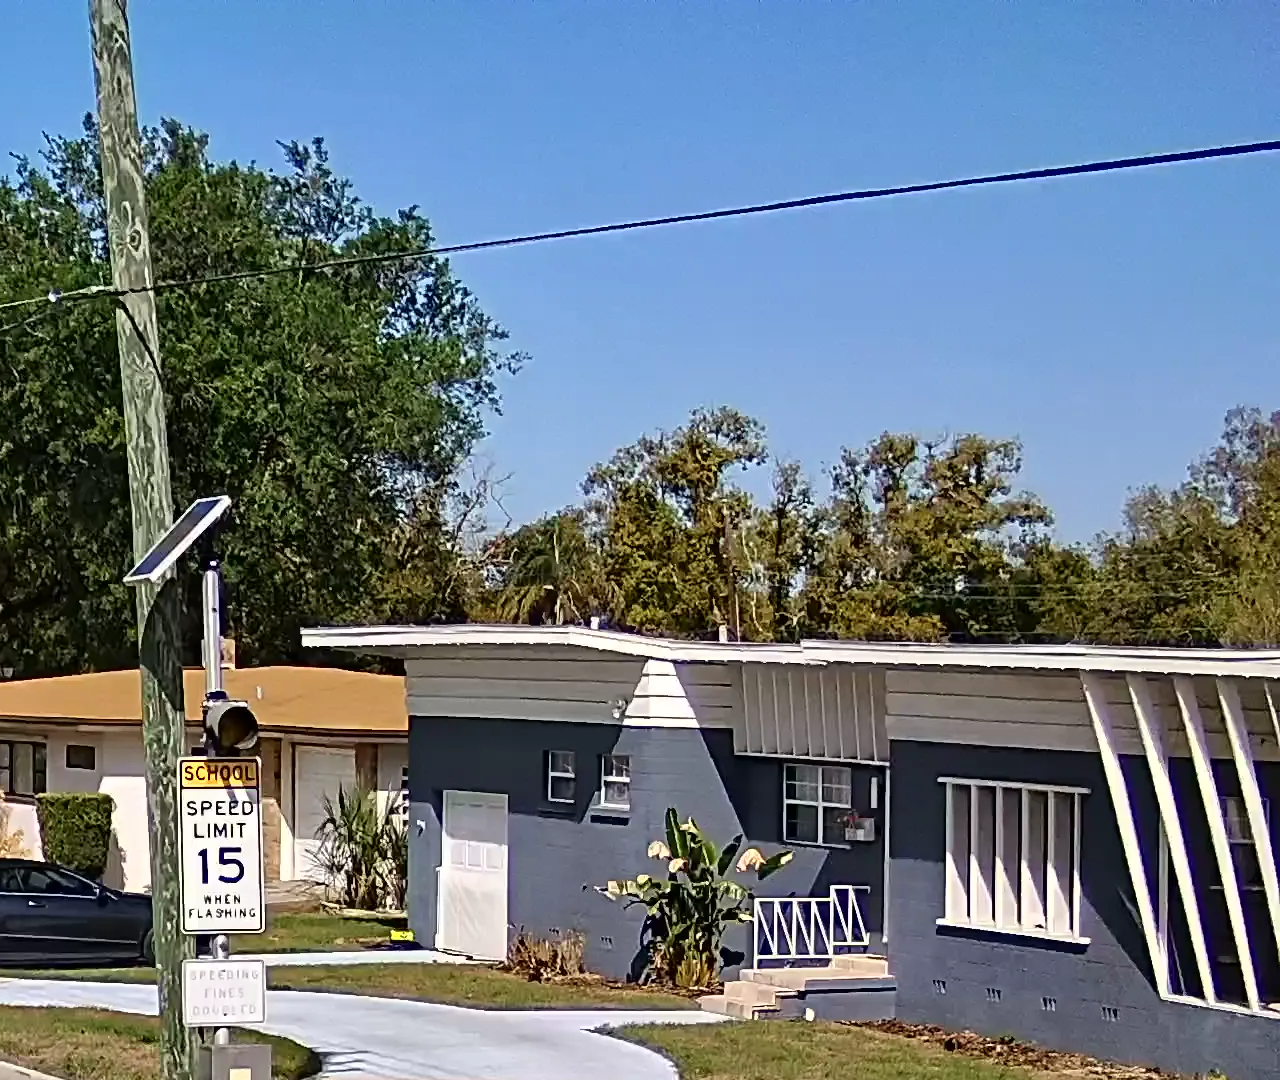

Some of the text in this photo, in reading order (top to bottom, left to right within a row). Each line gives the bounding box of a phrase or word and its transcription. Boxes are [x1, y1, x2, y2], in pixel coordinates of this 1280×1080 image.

[184, 765, 256, 781] SCHOOL
[186, 800, 254, 816] SPEED
[193, 822, 246, 838] LIMIT
[197, 846, 245, 885] 15
[203, 893, 241, 905] WHEN
[188, 907, 256, 919] FLASHING
[189, 968, 260, 981] SPEEDING
[203, 986, 245, 999] FINES
